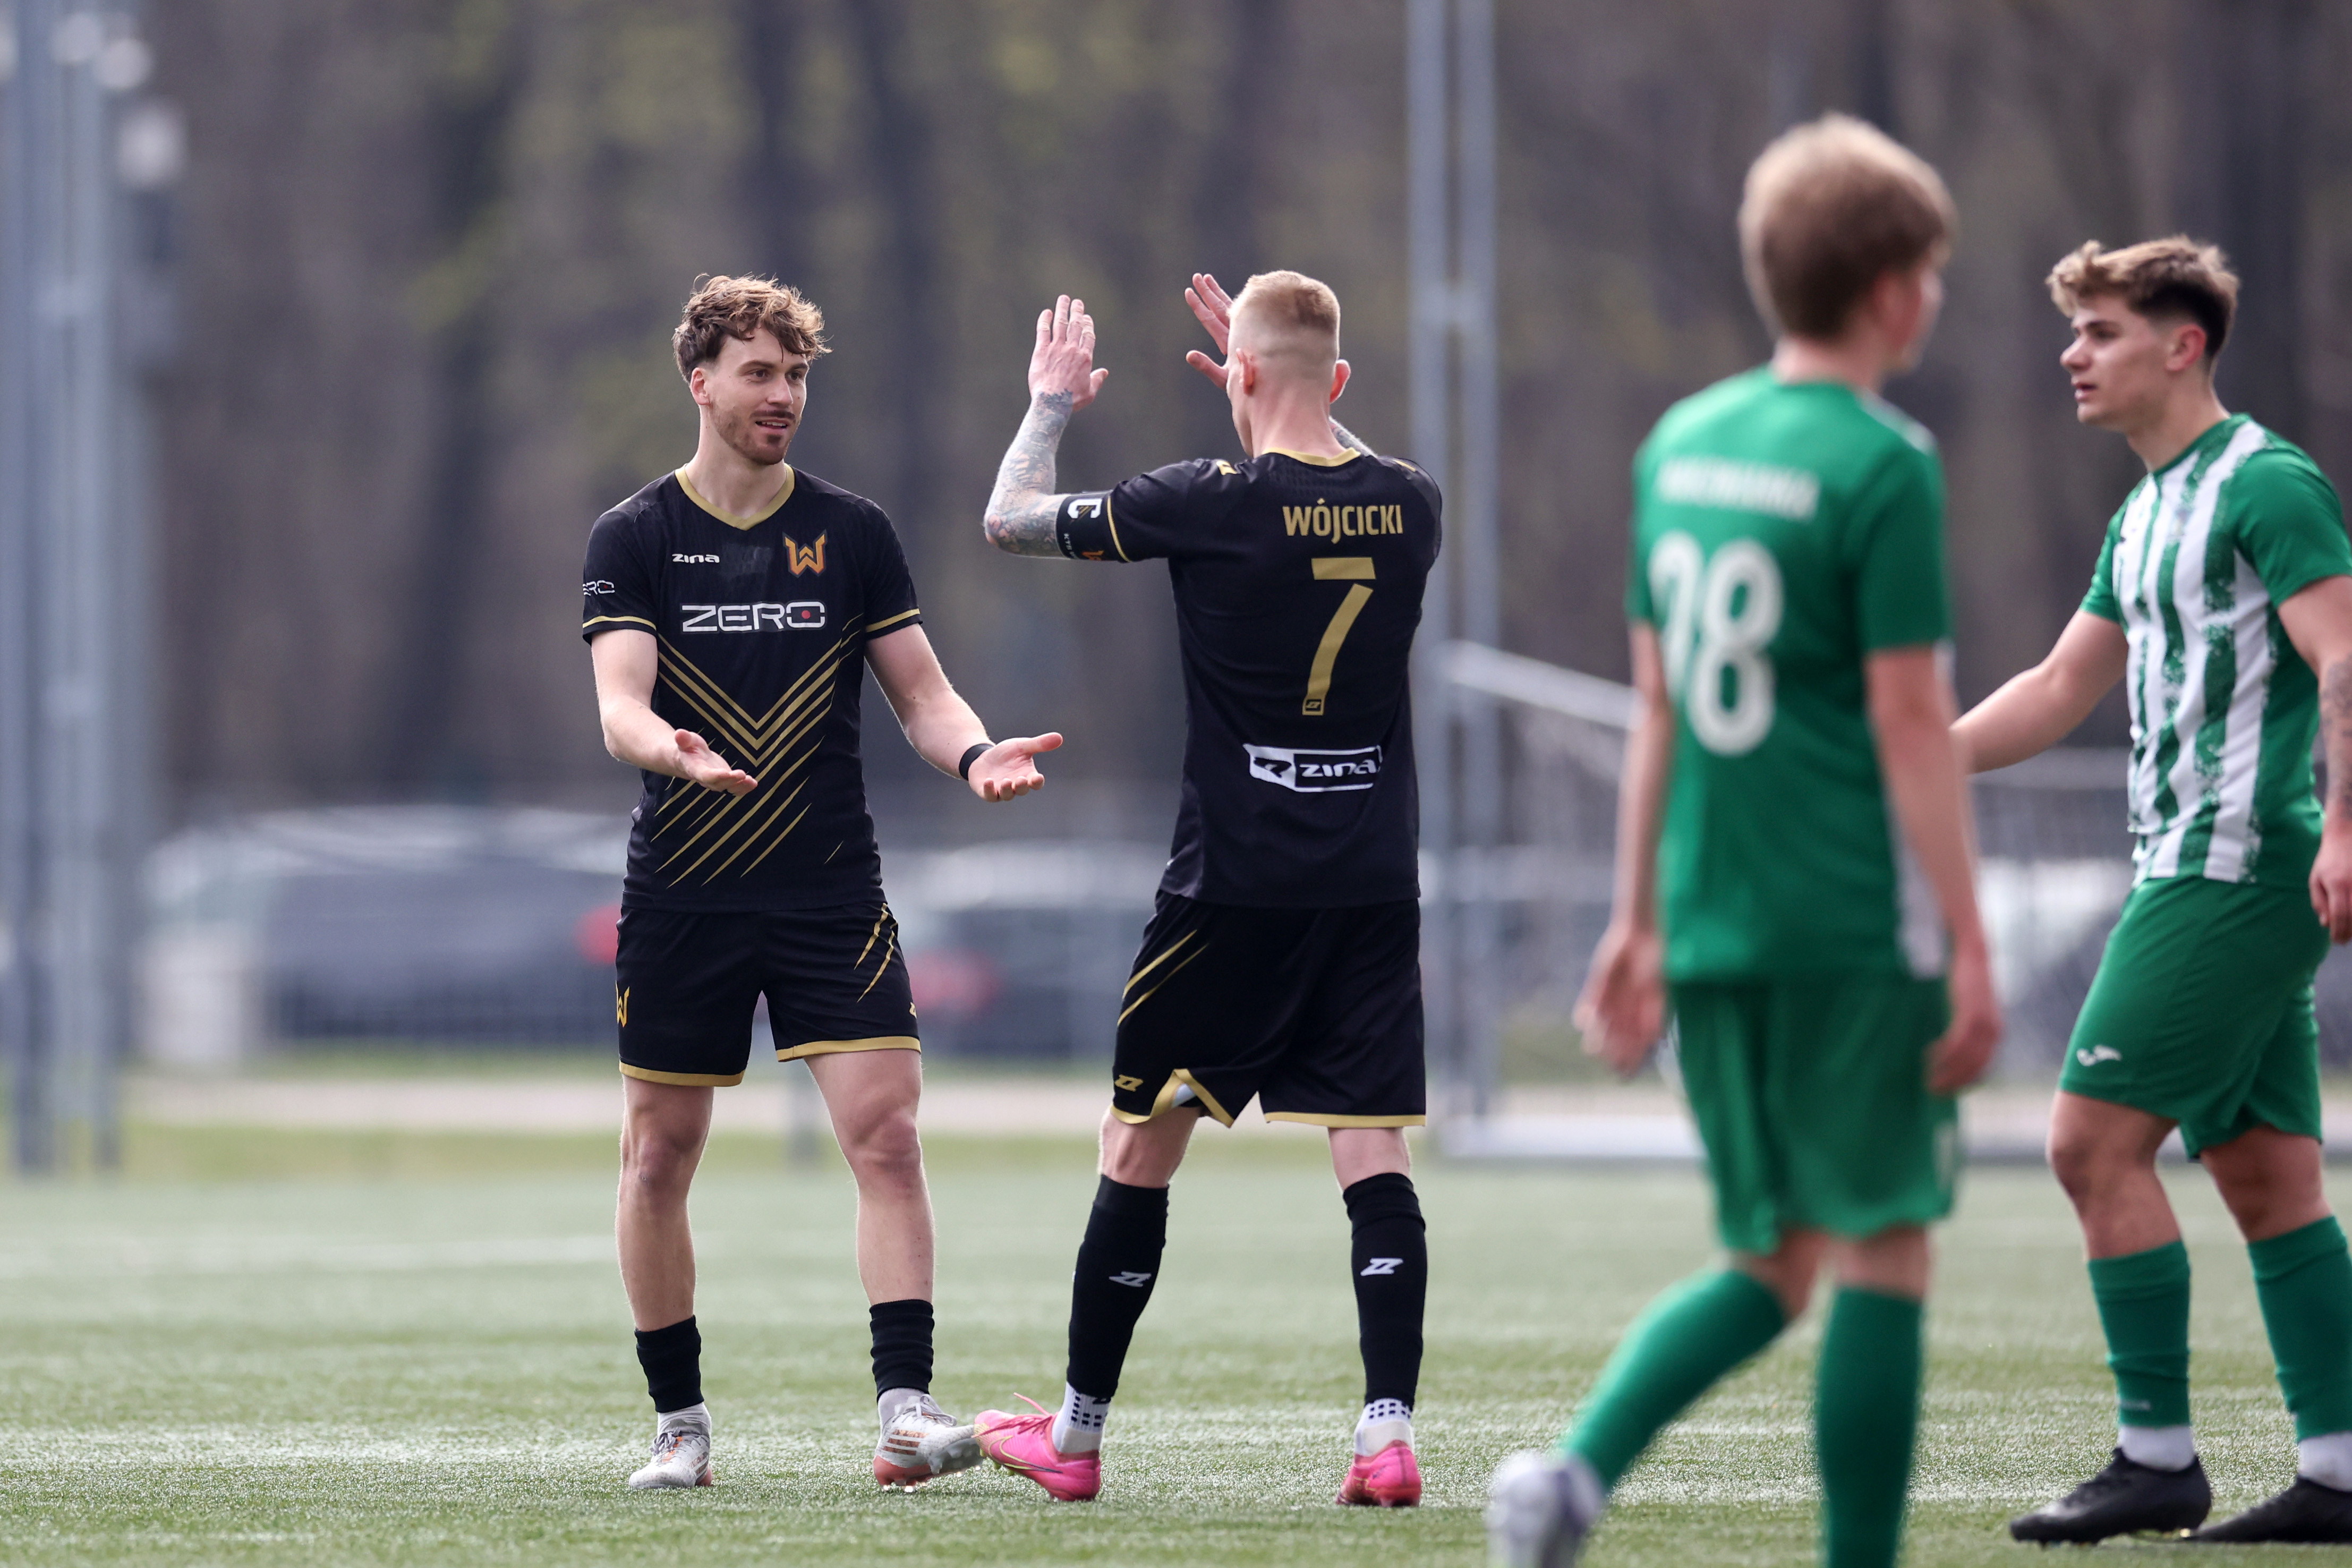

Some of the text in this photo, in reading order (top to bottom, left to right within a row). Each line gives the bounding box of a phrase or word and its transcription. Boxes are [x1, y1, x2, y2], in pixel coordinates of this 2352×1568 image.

[1282, 497, 1403, 544] WÓJCICKI
[672, 553, 720, 563] zina
[682, 601, 825, 632] ZERO
[1301, 557, 1376, 715] 7
[1299, 759, 1377, 777] zina
